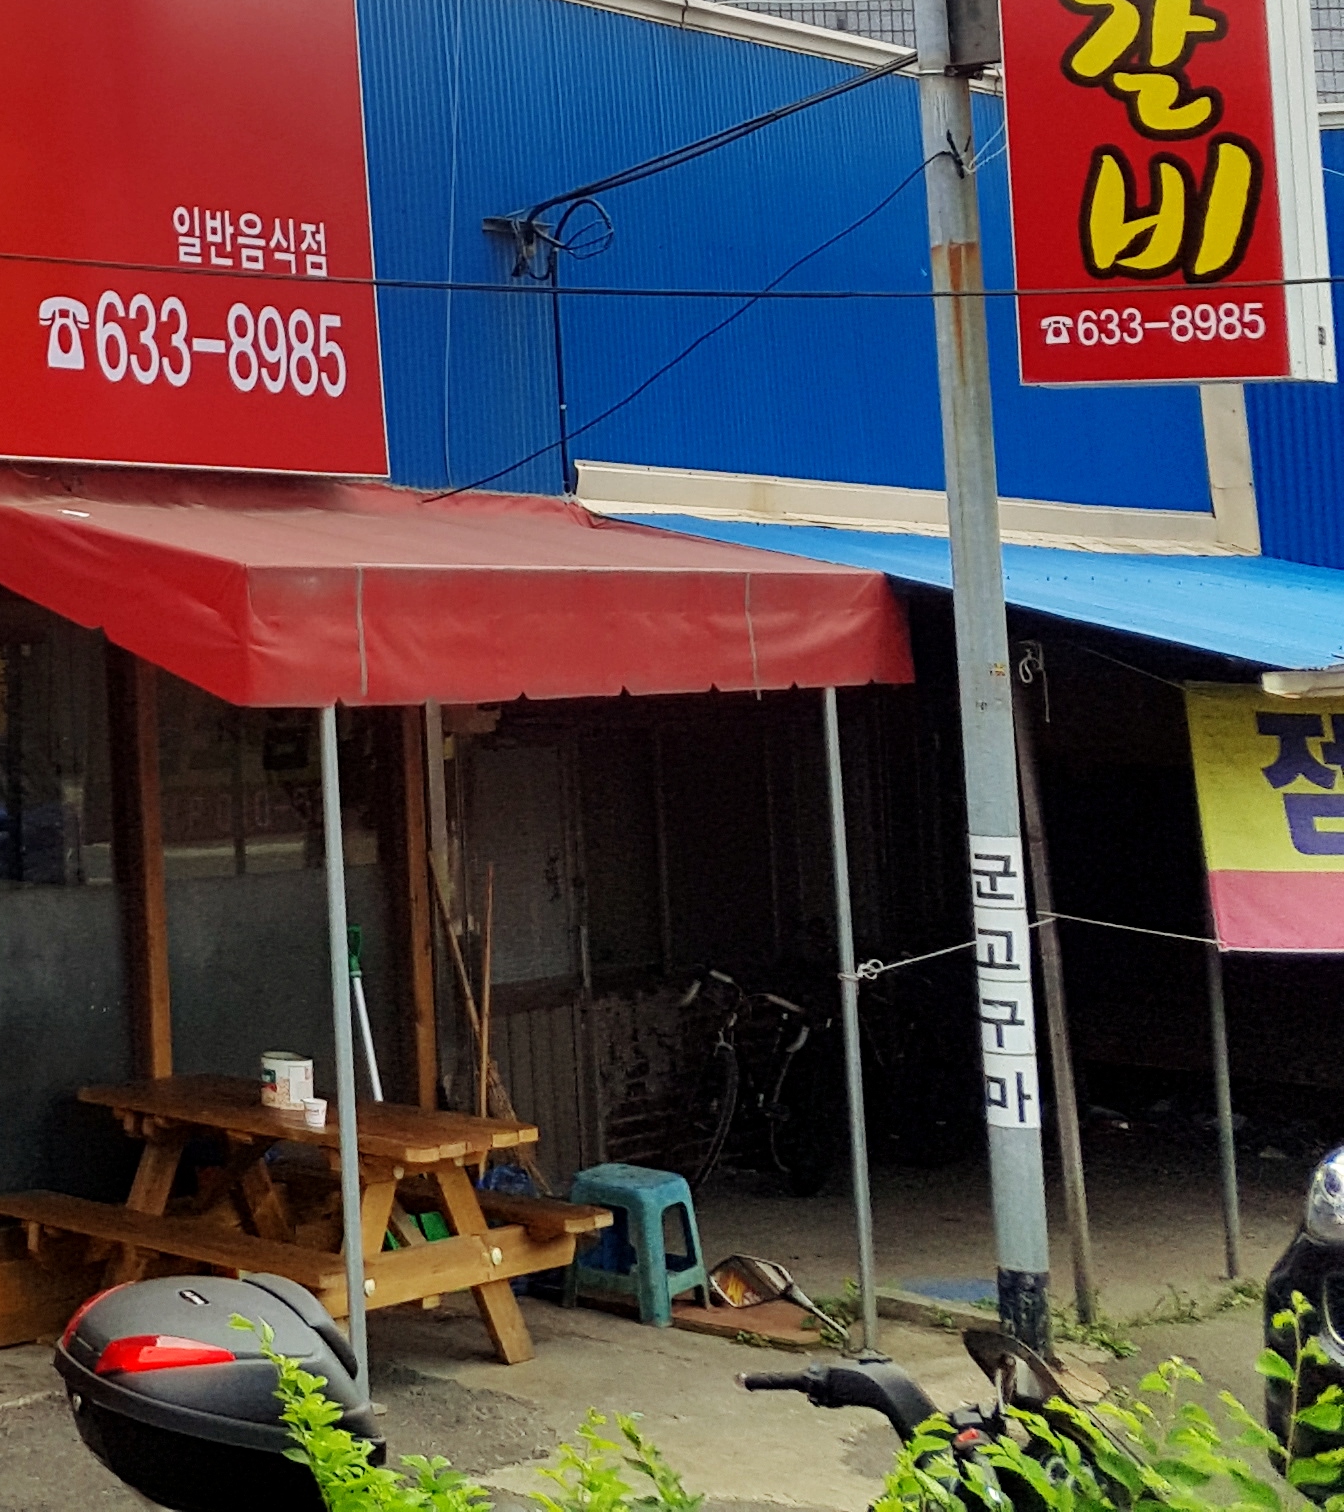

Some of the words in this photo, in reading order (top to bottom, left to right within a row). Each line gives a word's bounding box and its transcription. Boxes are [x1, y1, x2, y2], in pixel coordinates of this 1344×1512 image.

[172, 205, 329, 277] 일반음식점
[95, 289, 348, 398] 633-8985
[1076, 301, 1266, 347] 633-8985
[971, 852, 1033, 1125] 군고구마
